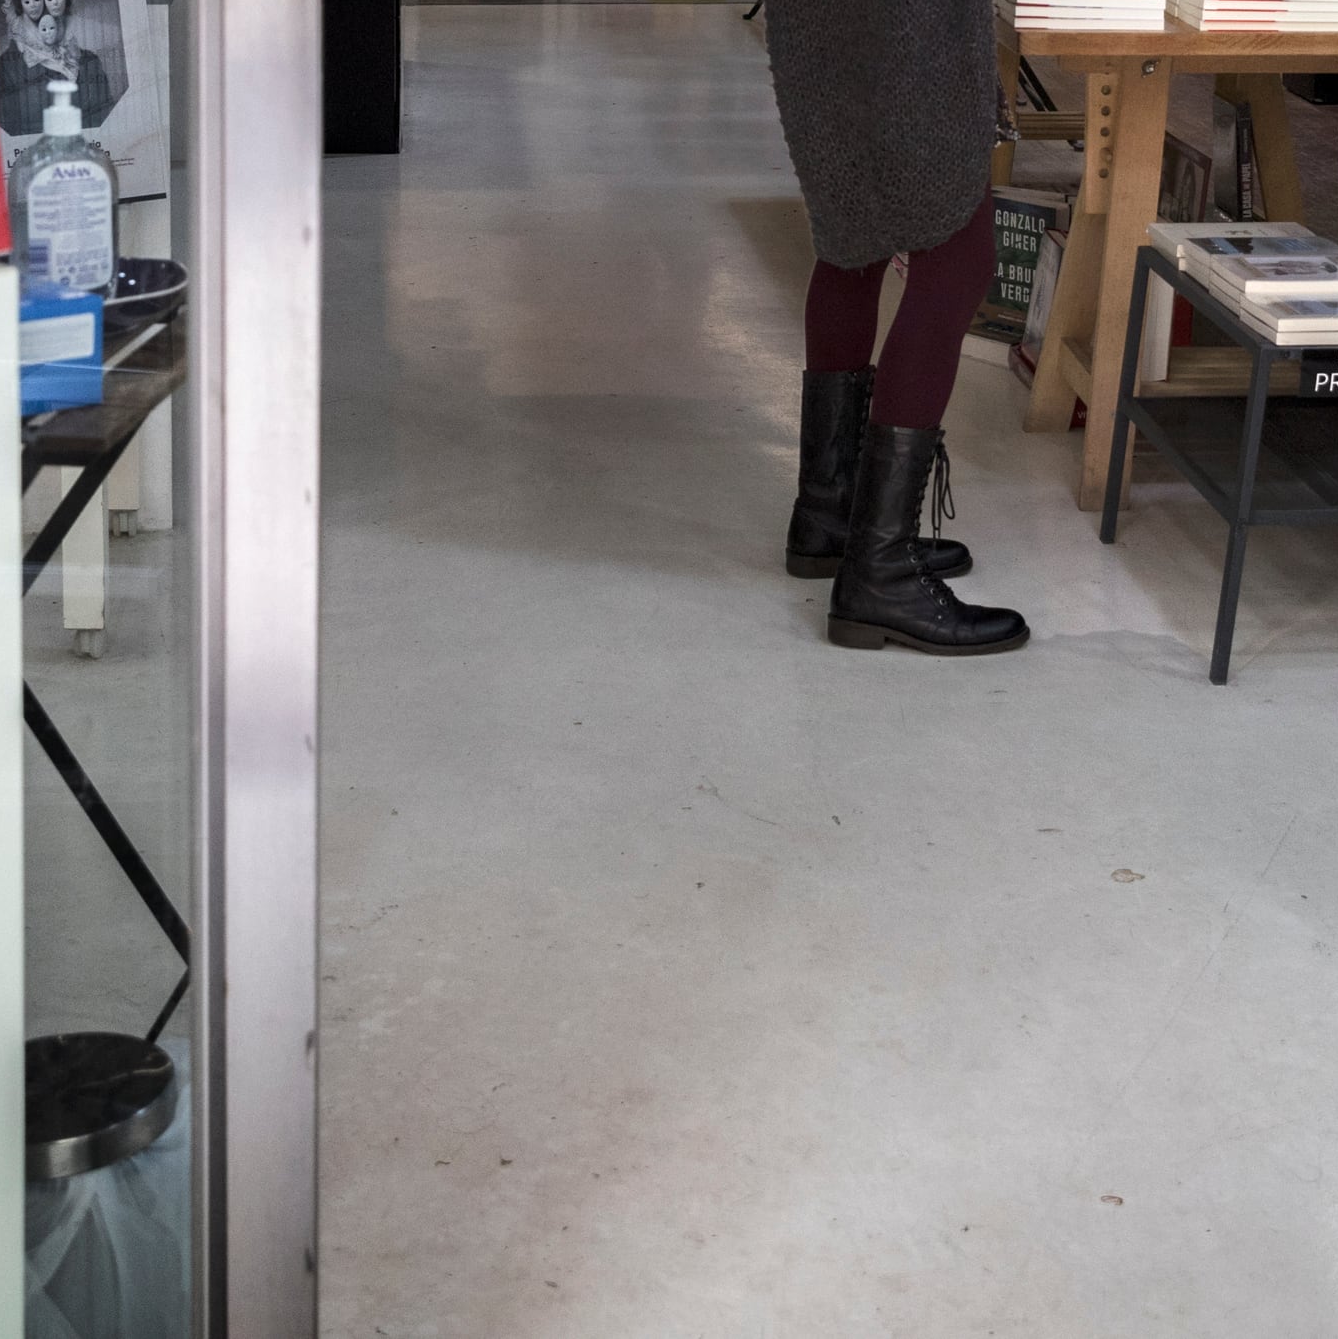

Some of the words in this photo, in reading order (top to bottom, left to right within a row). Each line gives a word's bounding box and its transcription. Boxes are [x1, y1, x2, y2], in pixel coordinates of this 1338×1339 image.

[1242, 163, 1251, 181] PAPEL
[1243, 191, 1252, 211] CASA
[995, 209, 1046, 233] GONZALO
[1002, 231, 1037, 252] GINER
